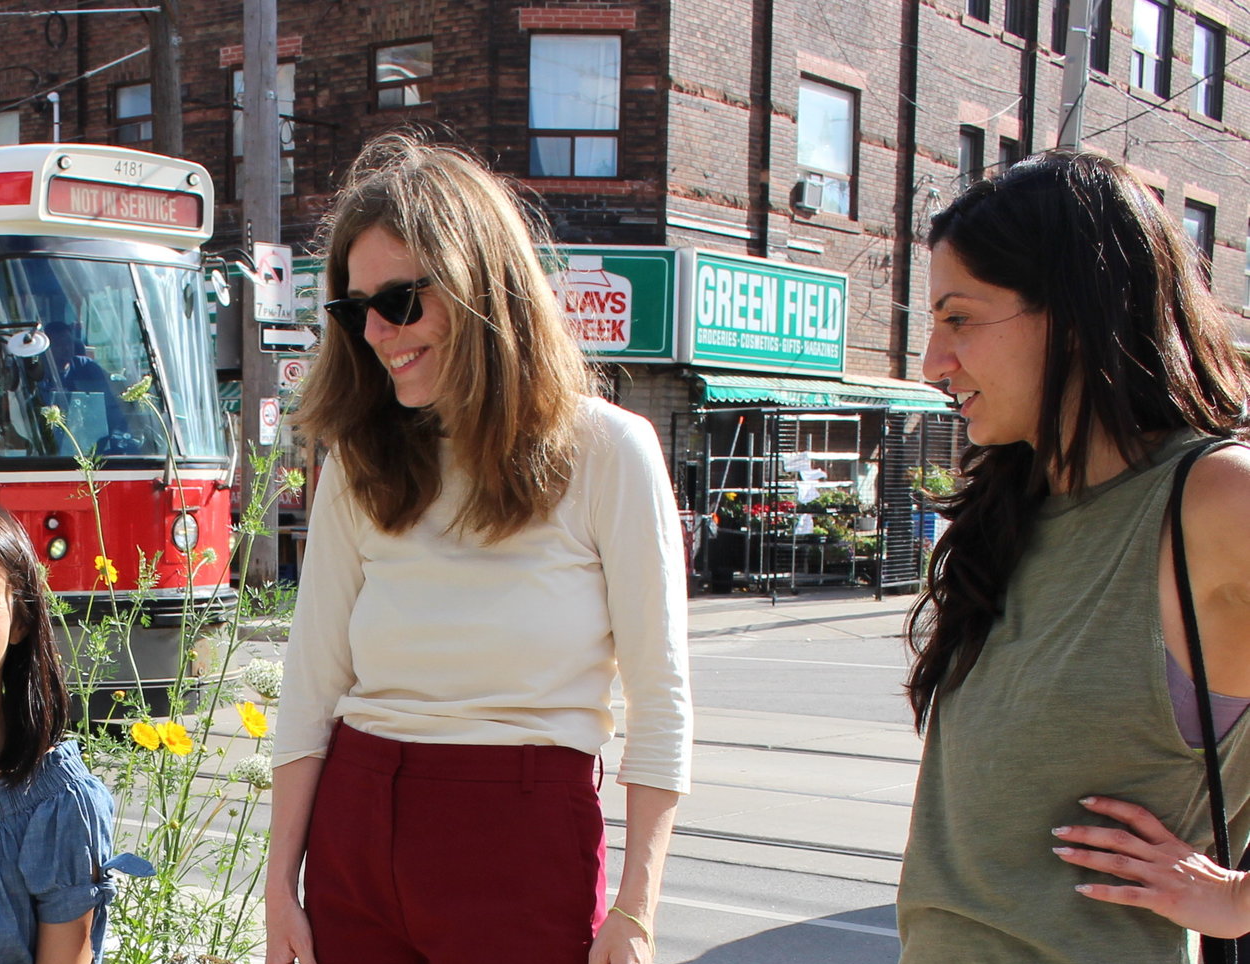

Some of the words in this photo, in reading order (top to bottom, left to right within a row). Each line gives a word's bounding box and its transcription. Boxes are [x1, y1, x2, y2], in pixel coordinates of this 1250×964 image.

[114, 160, 143, 178] 4181
[70, 187, 99, 215] NOT
[102, 190, 117, 217] IN
[120, 194, 178, 223] SERVICE
[565, 290, 627, 314] DAYS
[698, 264, 778, 334] GREEN
[782, 279, 842, 341] FIELD
[696, 327, 738, 348] GROCERIES
[740, 332, 780, 352] COSMETICS
[781, 339, 801, 354] GIFTS
[803, 342, 839, 359] MAGAZINES
